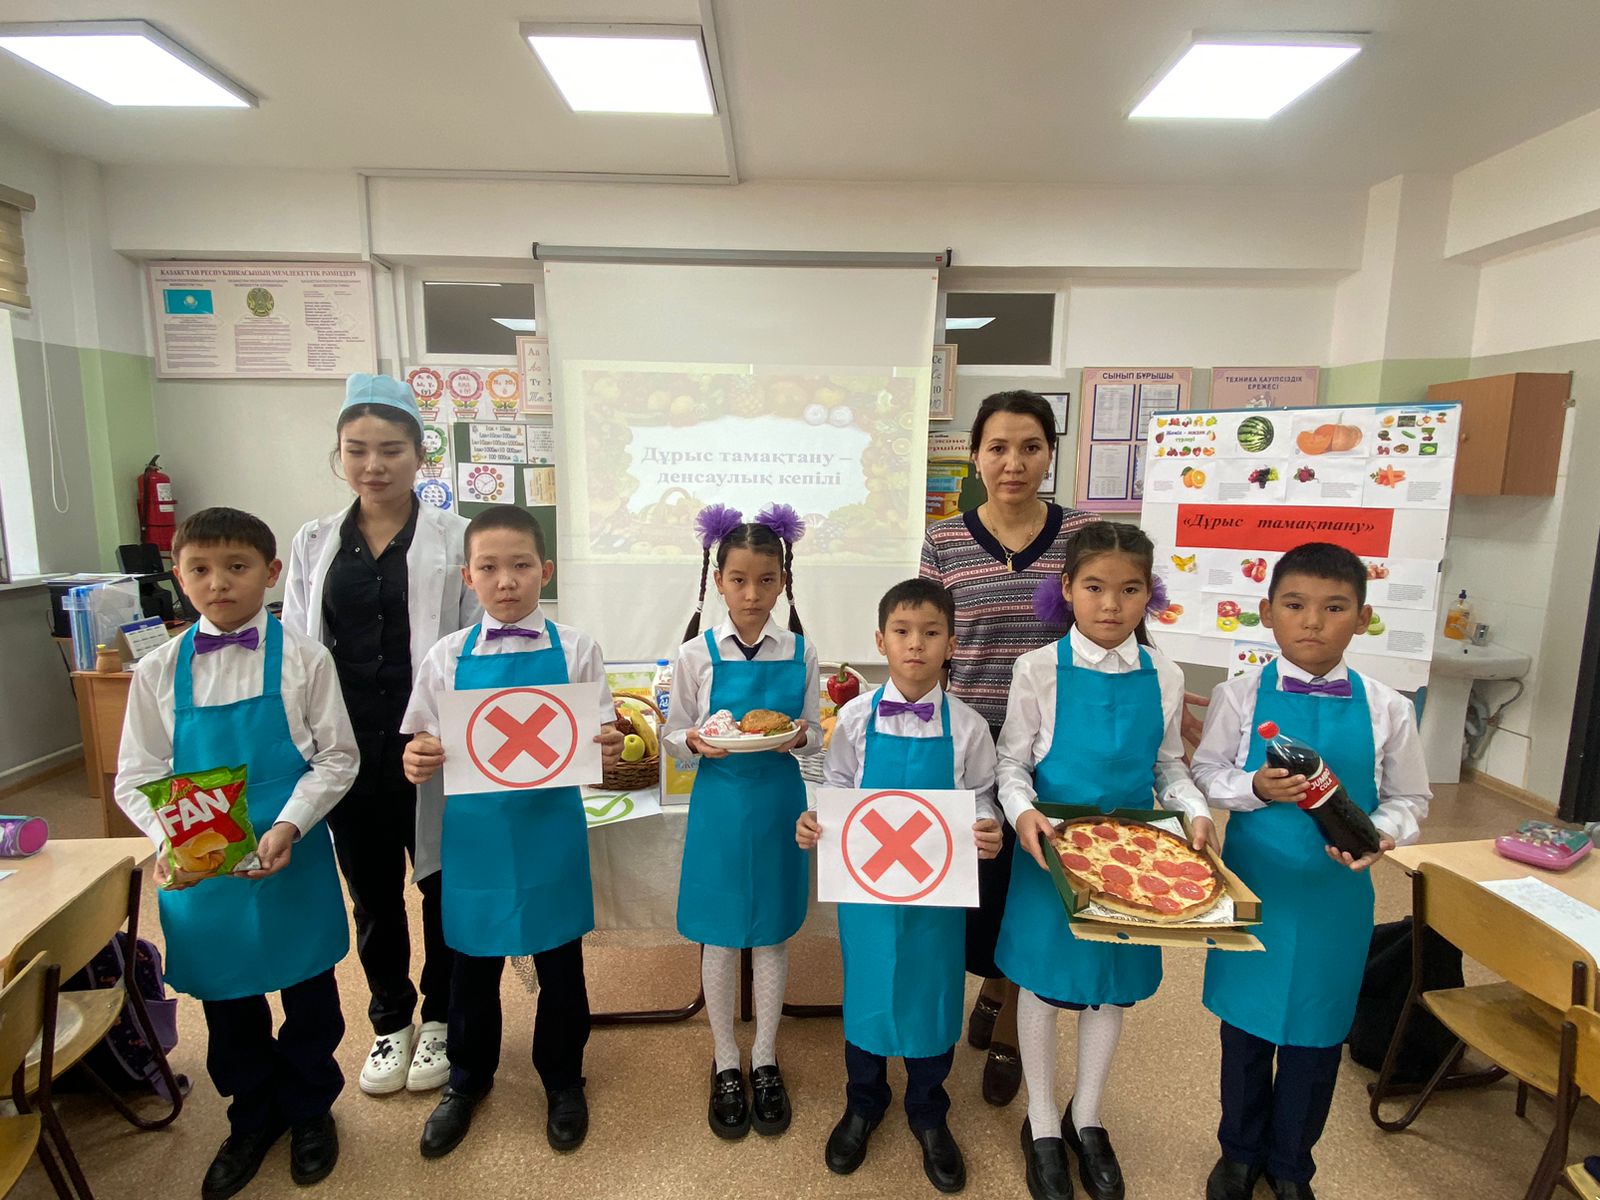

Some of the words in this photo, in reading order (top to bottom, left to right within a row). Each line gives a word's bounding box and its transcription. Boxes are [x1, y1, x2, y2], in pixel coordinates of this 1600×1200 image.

[1102, 372, 1135, 380] СЫНЫП
[1136, 372, 1174, 380] БҰРЫШЫ
[641, 447, 713, 465] Дұрыс
[719, 451, 834, 467] тамақтану
[657, 472, 773, 487] денсаулық
[778, 472, 841, 485] кепілі
[1183, 513, 1244, 529] «Дұрыс
[1257, 517, 1375, 535] тамақтану»
[156, 788, 230, 838] FAN
